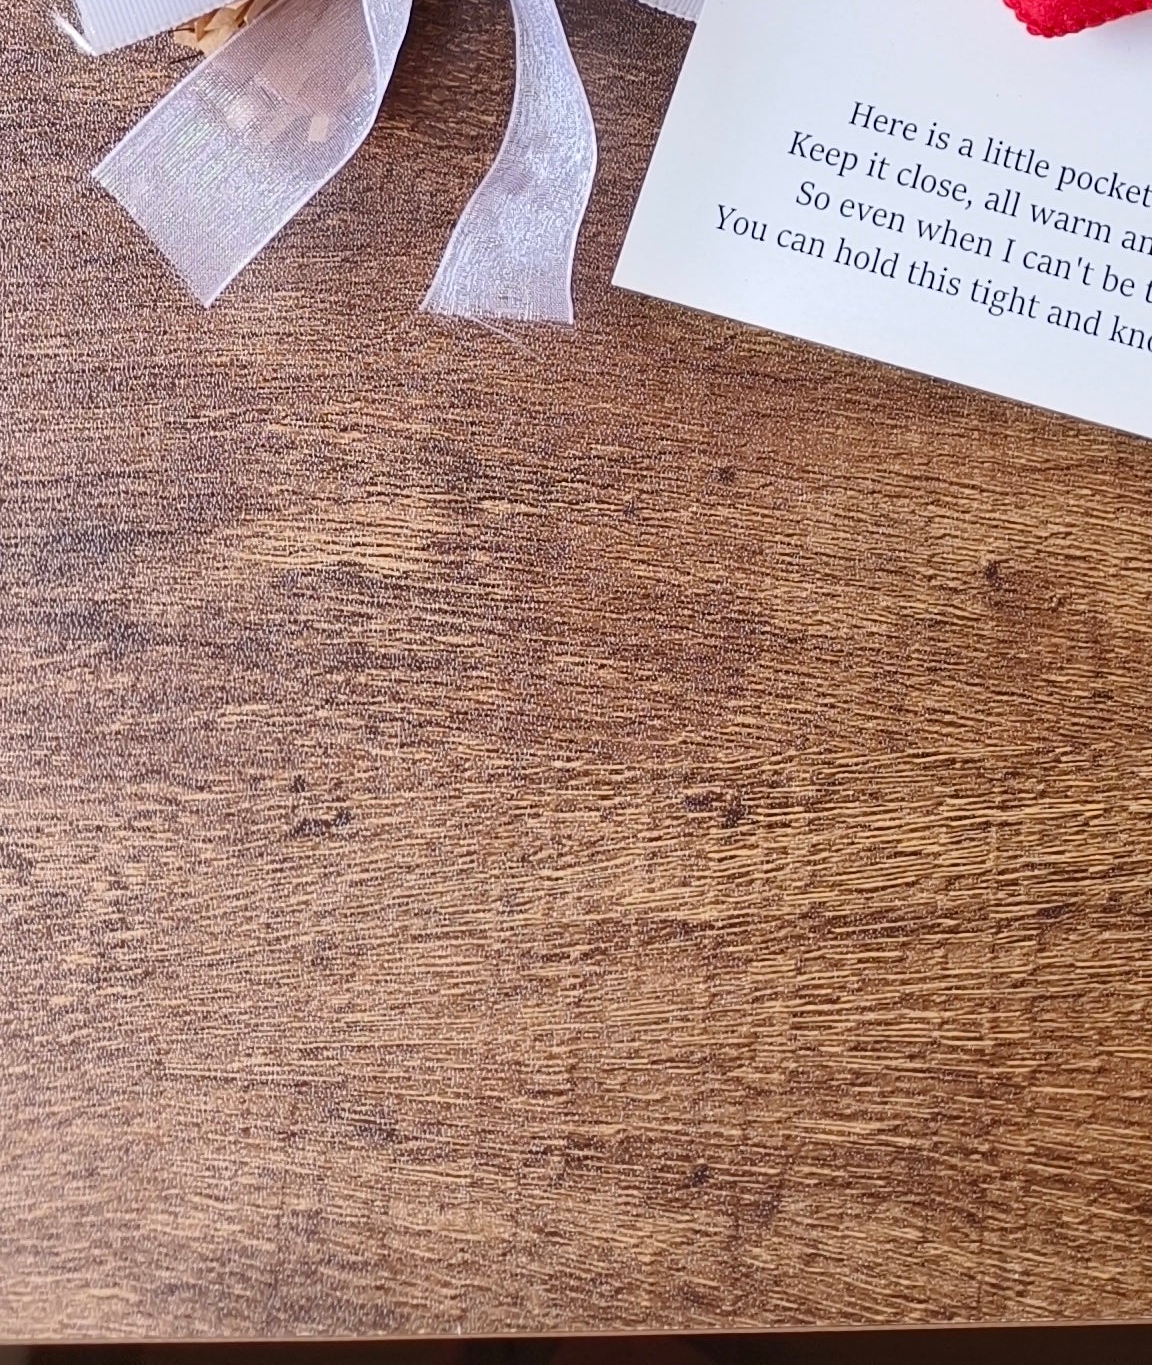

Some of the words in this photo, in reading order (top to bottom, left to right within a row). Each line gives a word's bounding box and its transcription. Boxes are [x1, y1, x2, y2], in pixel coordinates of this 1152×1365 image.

[788, 130, 859, 177] Keep
[866, 152, 890, 180] it
[896, 163, 973, 210] close,
[984, 188, 1021, 218] all
[1030, 201, 1112, 243] warm
[848, 100, 918, 141] Here
[924, 121, 950, 150] is
[957, 137, 974, 158] a
[981, 137, 1050, 178] little
[715, 204, 768, 242] You
[776, 228, 826, 259] can
[833, 236, 900, 279] hold
[907, 260, 962, 297] this
[970, 277, 1041, 317] tight
[1046, 304, 1102, 337] and
[796, 180, 830, 211] So
[839, 197, 905, 233] even
[916, 218, 993, 257] when
[1001, 237, 1017, 264] I
[1022, 249, 1095, 286] can't
[1102, 264, 1135, 297] be
